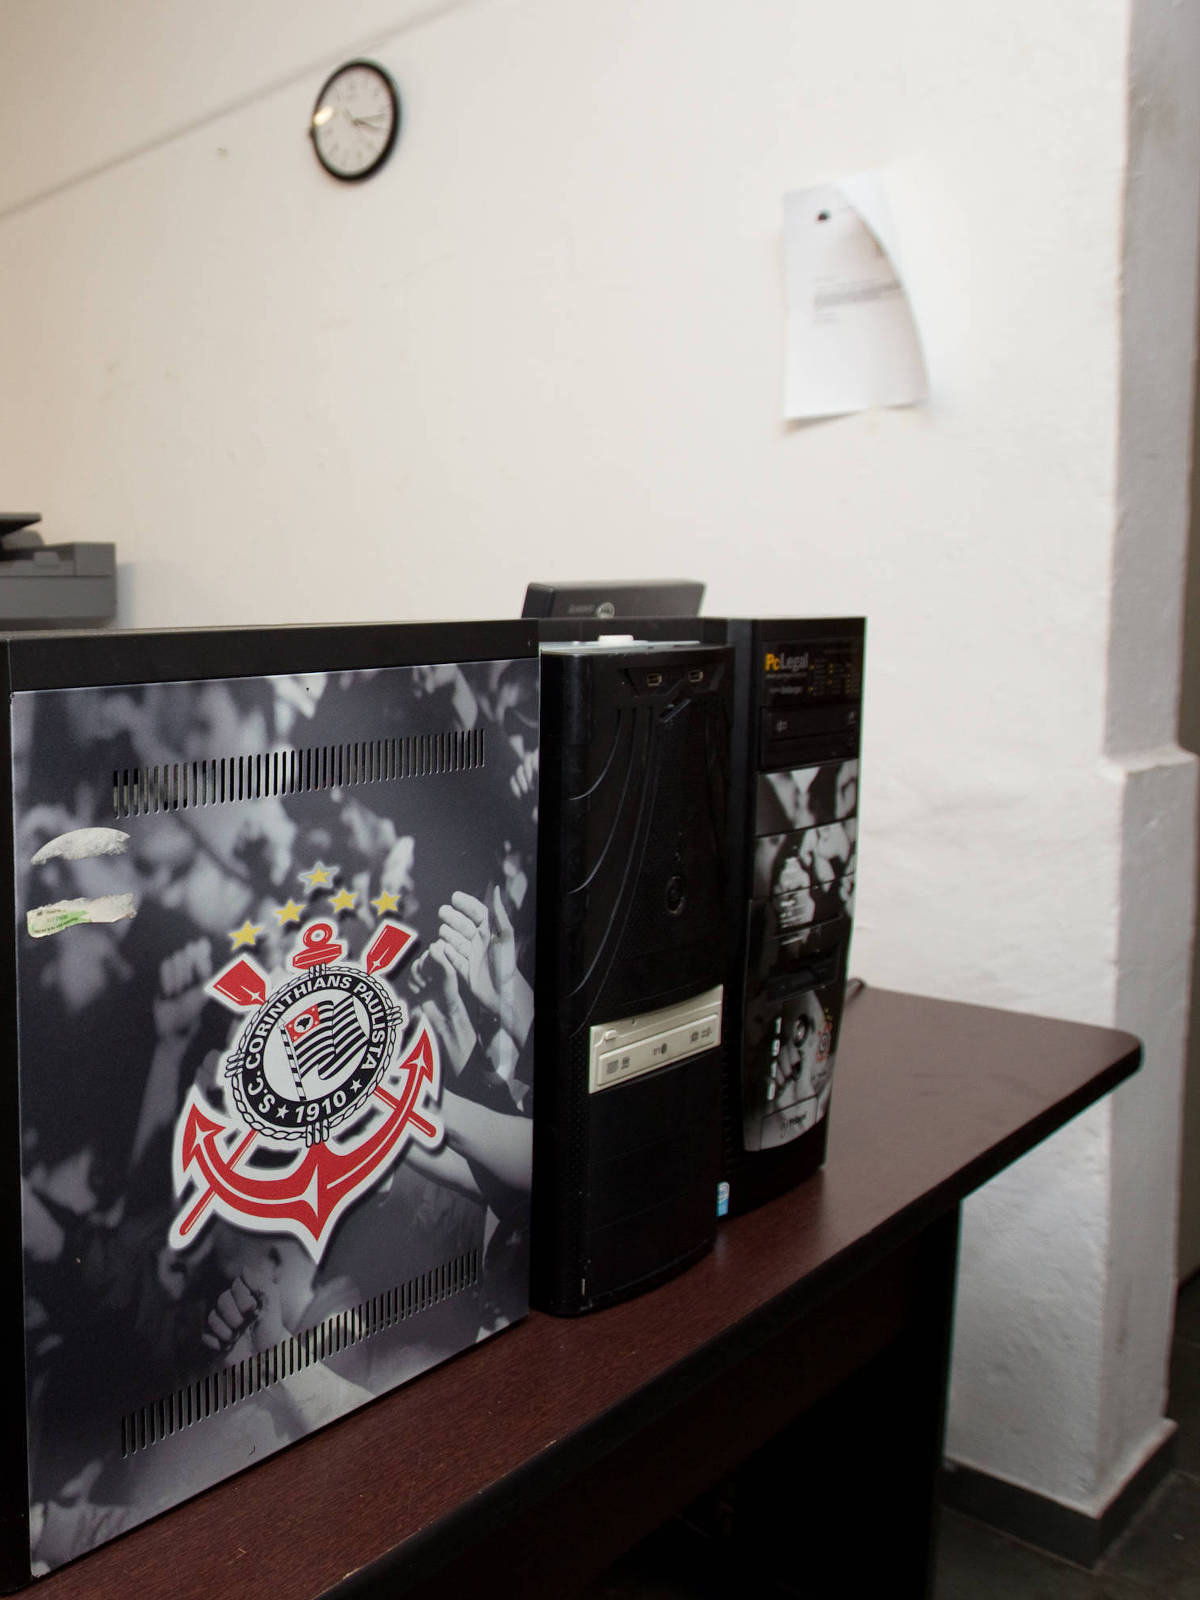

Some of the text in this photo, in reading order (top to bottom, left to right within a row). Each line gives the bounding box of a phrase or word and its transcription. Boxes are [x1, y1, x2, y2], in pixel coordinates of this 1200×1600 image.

[245, 975, 352, 1070] CORINTHIANS
[354, 982, 386, 1070] PAULISTA
[295, 1090, 346, 1124] 1910
